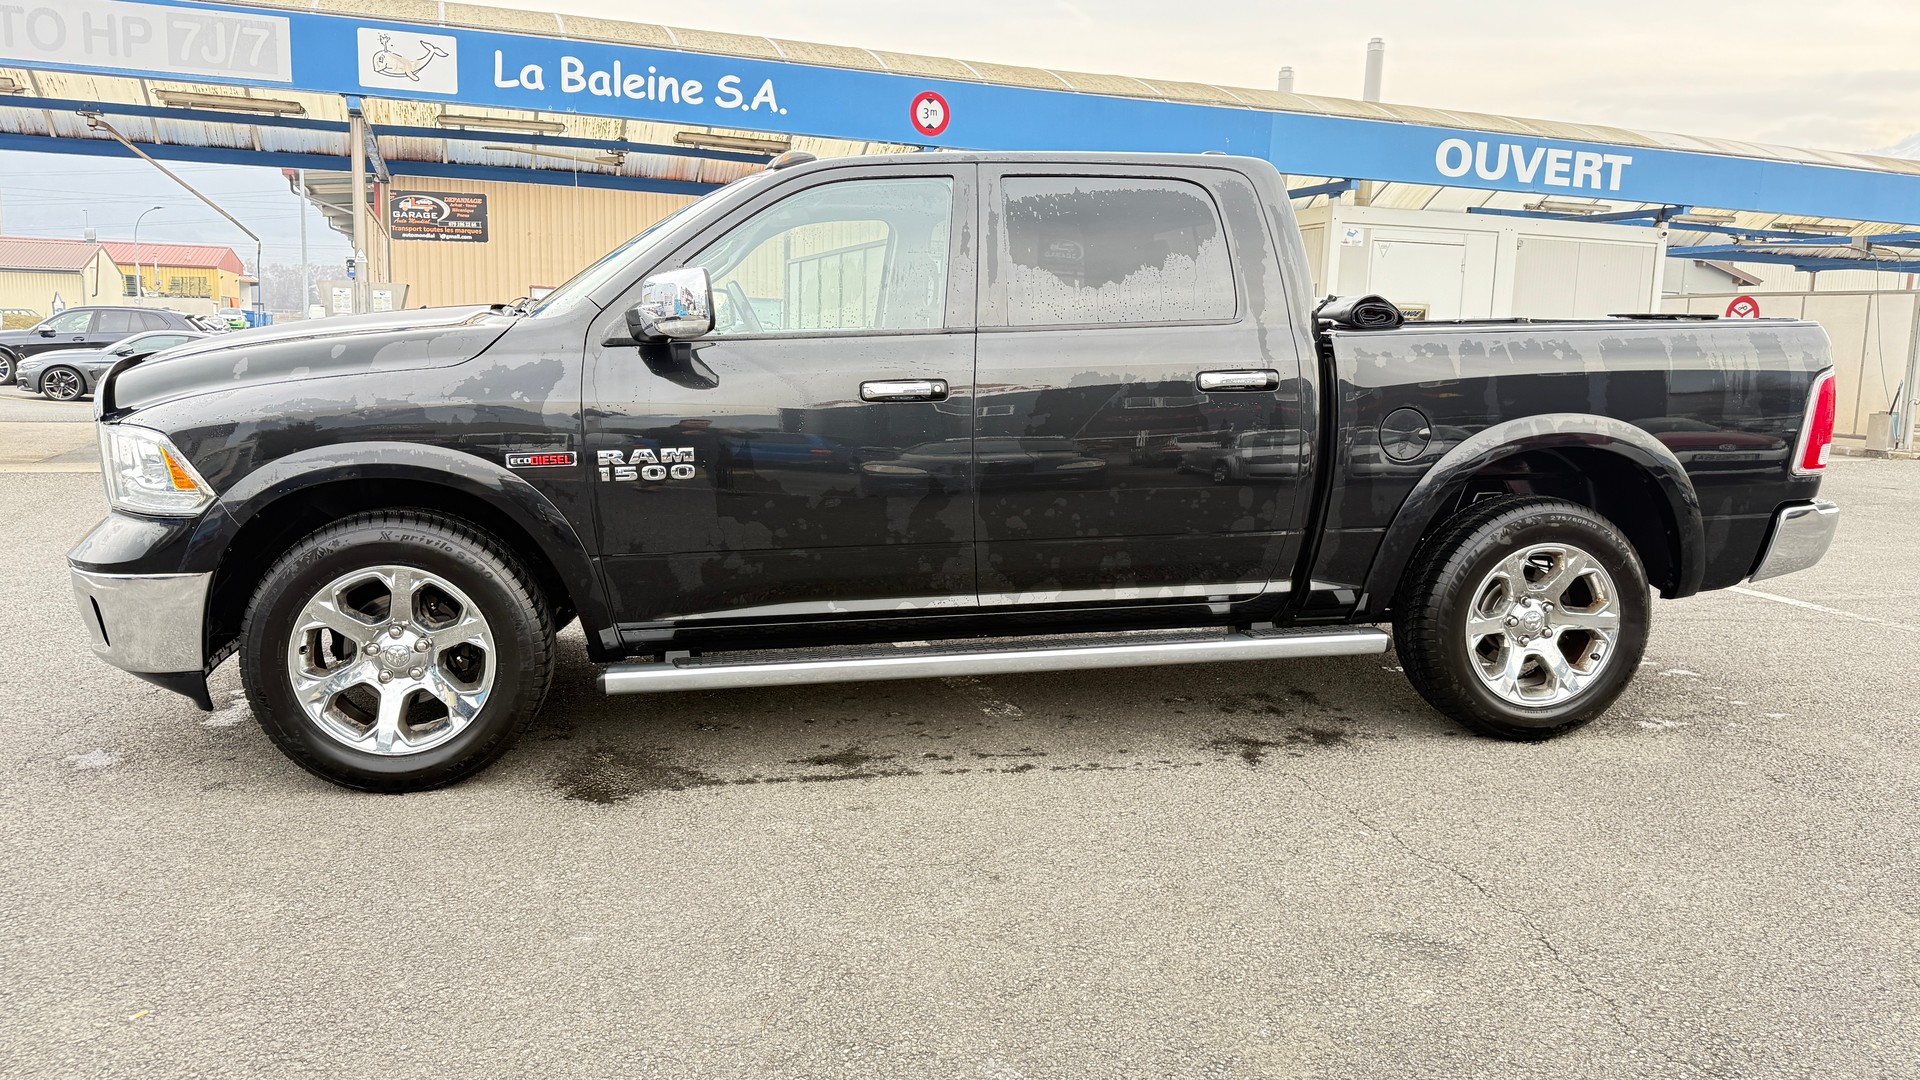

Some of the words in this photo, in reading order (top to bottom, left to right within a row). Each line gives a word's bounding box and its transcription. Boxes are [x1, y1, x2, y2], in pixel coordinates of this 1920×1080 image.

[82, 11, 154, 58] HP
[171, 20, 270, 69] 7J/7
[493, 49, 544, 91] La
[560, 55, 704, 106] Baleine
[714, 74, 788, 116] S.A.
[1435, 138, 1633, 191] OUVERT
[392, 211, 438, 219] GARAGE
[391, 225, 423, 233] Transport
[596, 447, 695, 465] RAM
[598, 464, 696, 482] 1500
